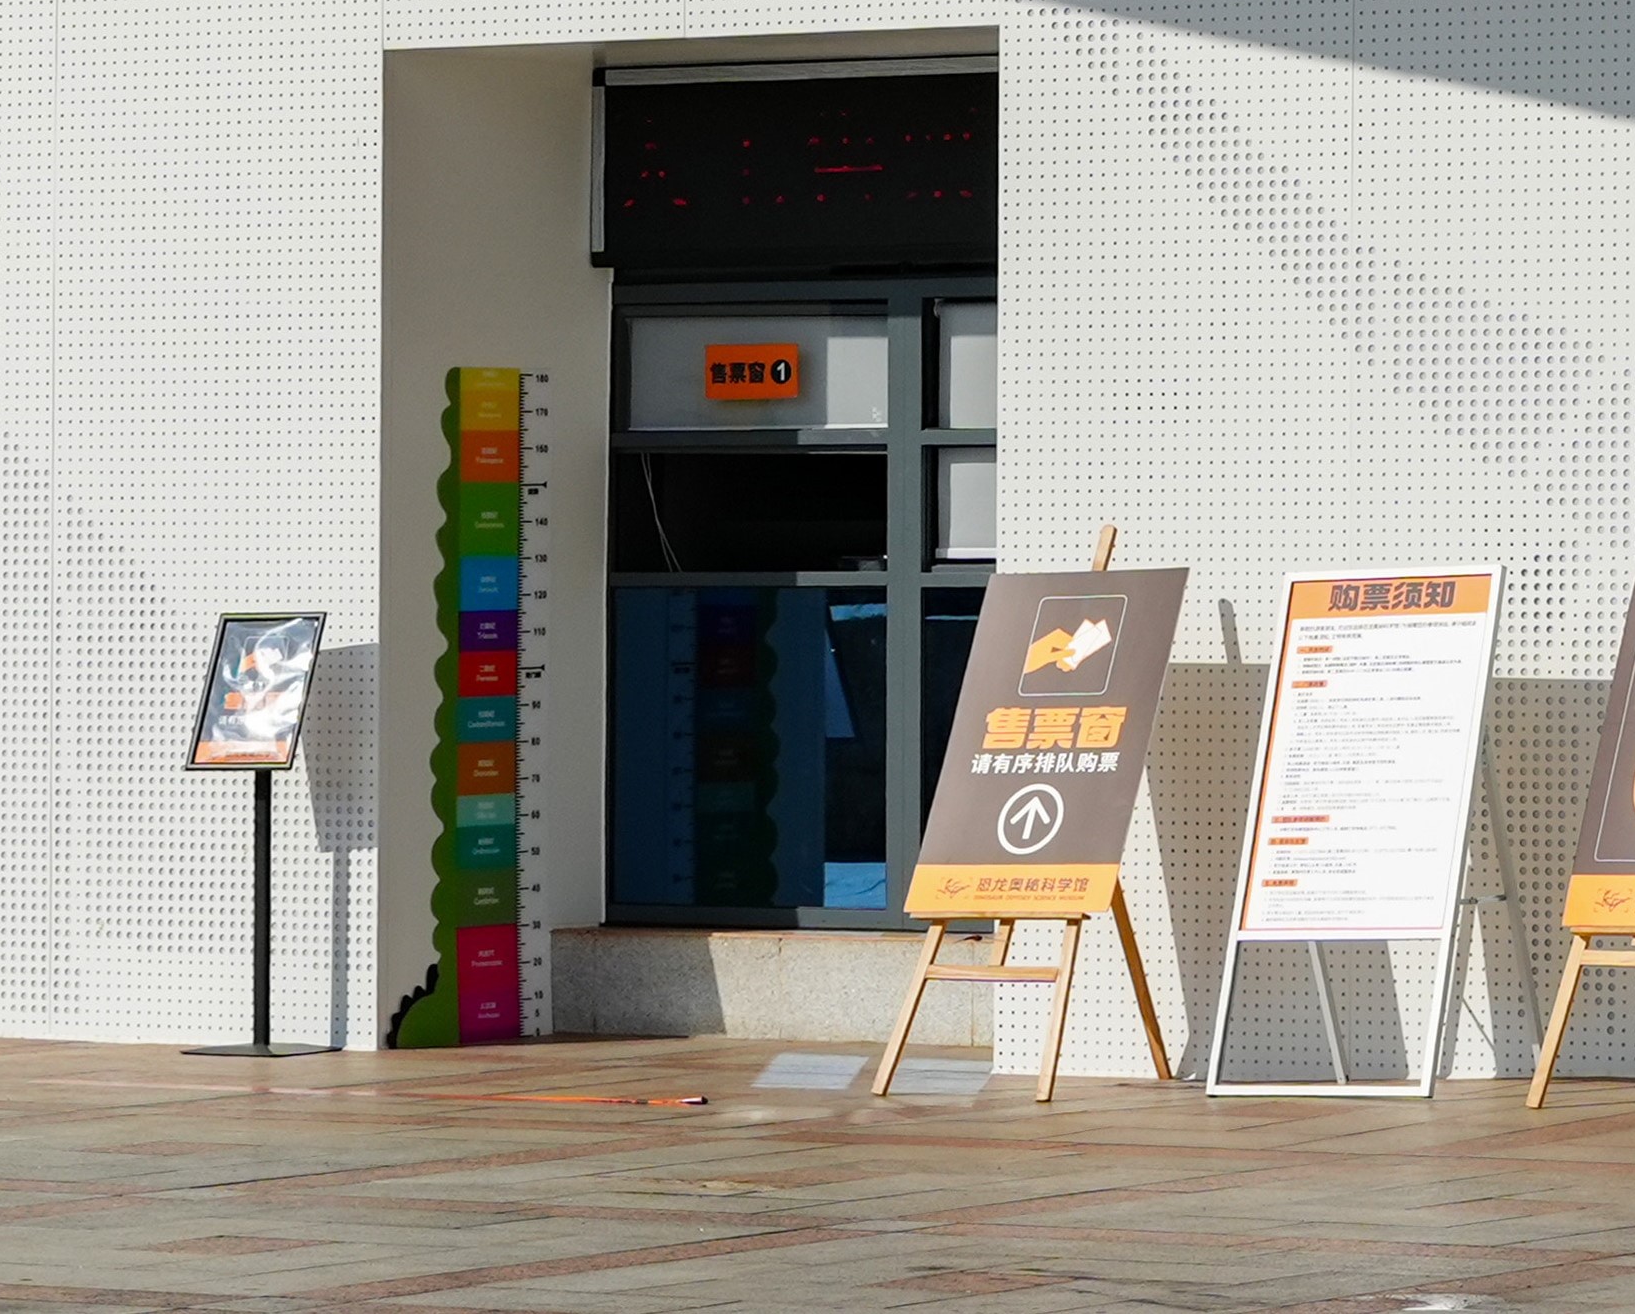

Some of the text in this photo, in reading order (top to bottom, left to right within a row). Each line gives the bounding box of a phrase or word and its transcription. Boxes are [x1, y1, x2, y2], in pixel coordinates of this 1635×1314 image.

[1328, 580, 1457, 611] 购票须知
[982, 706, 1128, 749] 售票窗
[971, 751, 1120, 774] 请有序排队购票
[976, 876, 1090, 893] 恐龙奥秘科学馆
